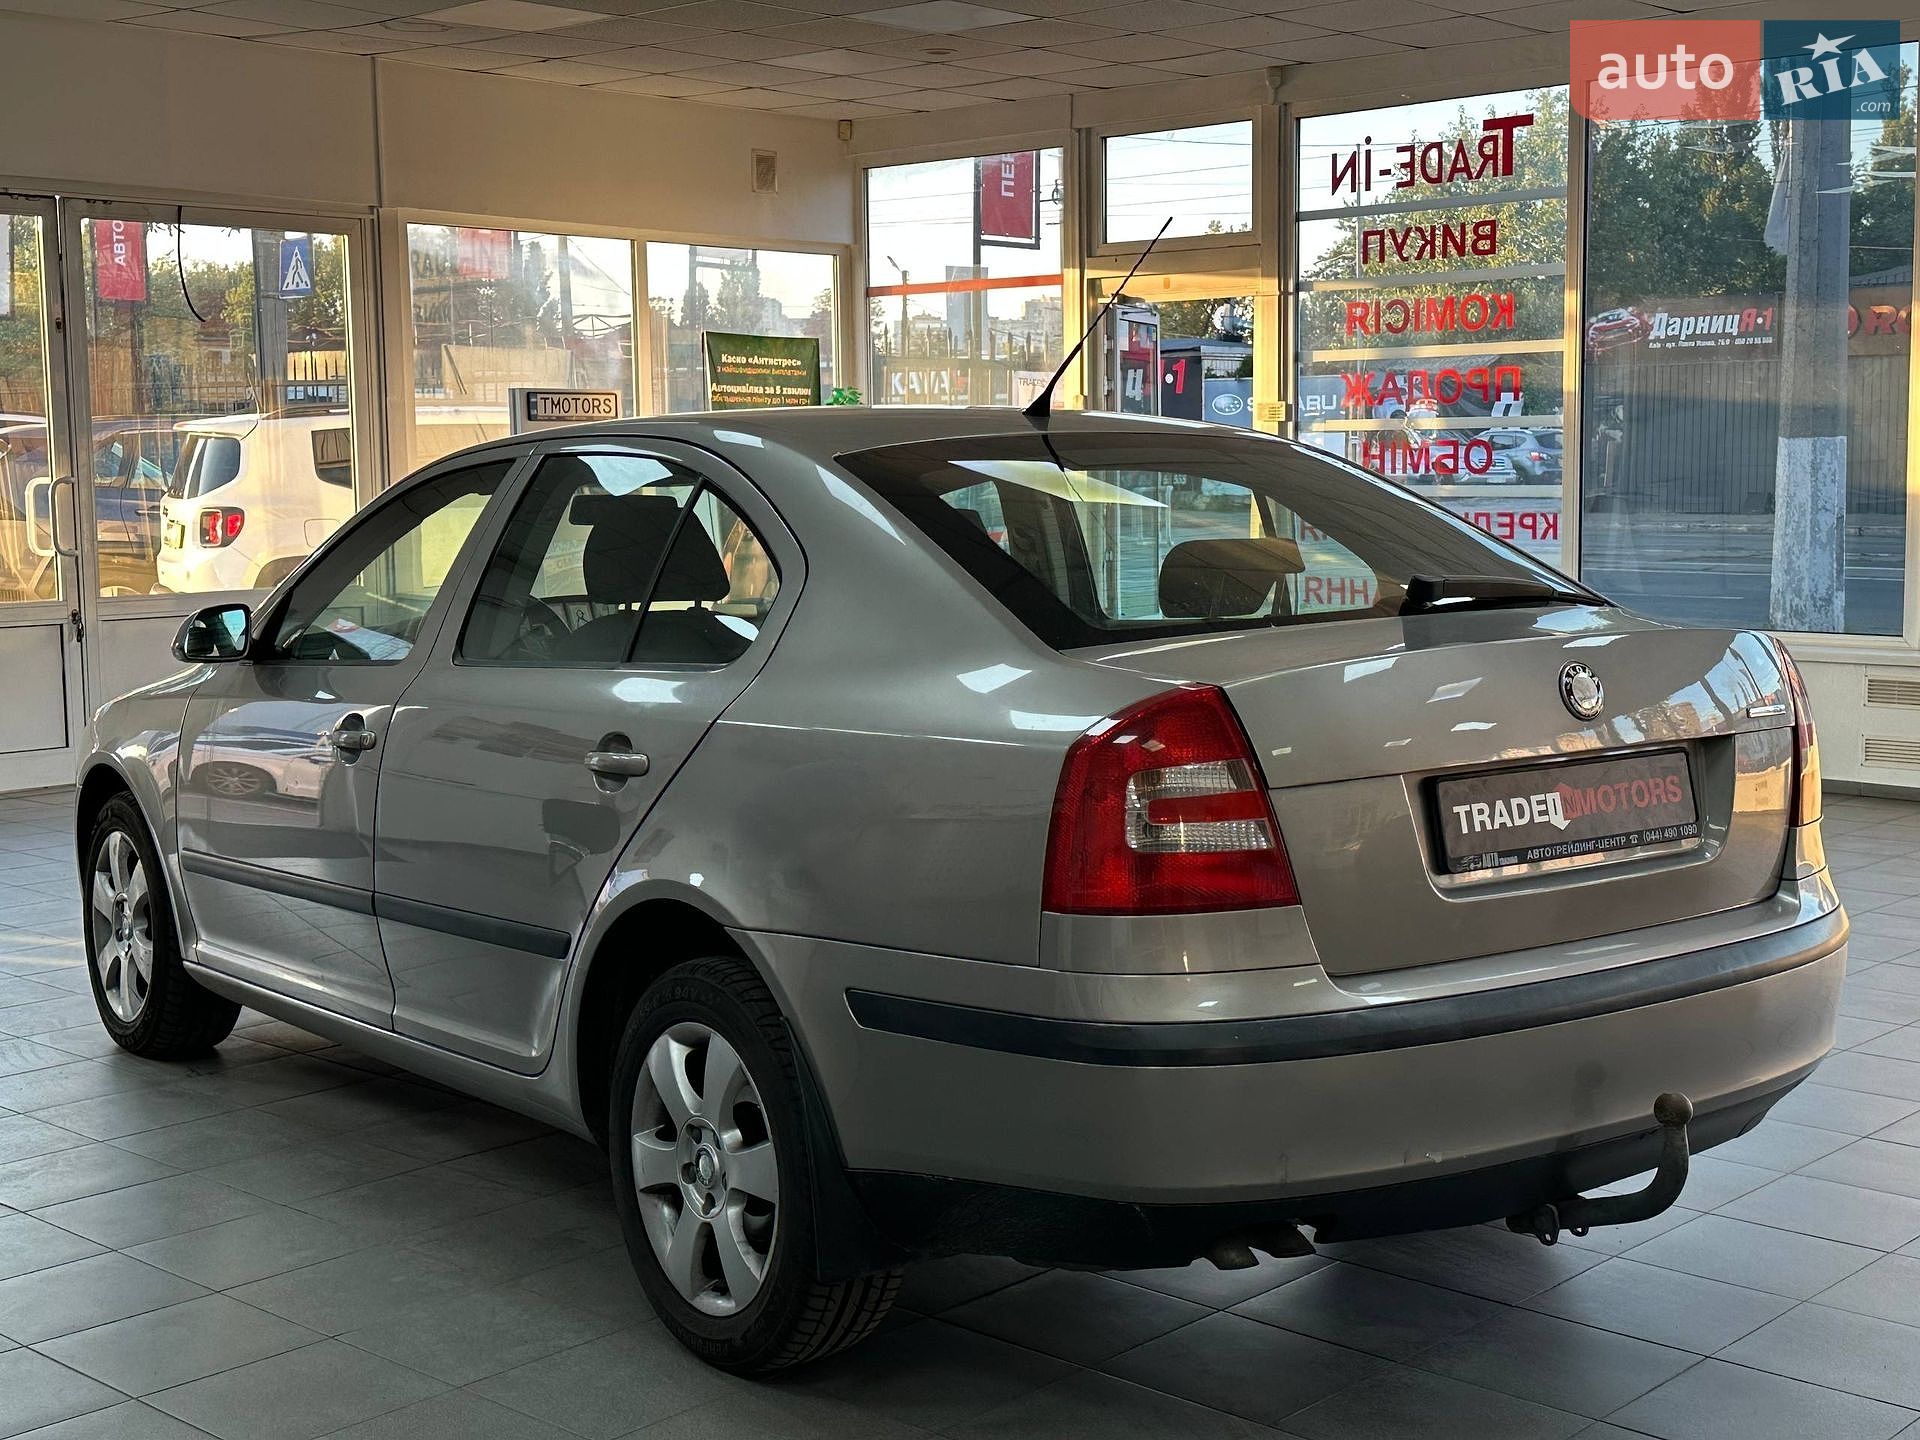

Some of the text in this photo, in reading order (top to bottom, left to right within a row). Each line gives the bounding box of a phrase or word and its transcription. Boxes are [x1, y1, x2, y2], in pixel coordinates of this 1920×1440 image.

[721, 354, 747, 364] Каско
[765, 386, 774, 395] за
[776, 386, 781, 395] 5
[540, 397, 612, 414] TMOTORS
[1453, 792, 1550, 834] TRADE
[1574, 775, 1682, 816] MOTORS
[1526, 837, 1627, 860] АВТОТРЕЙДИНГ-ЦЕНТР
[1643, 828, 1663, 844] (044)
[1664, 827, 1678, 840] 490
[1679, 824, 1698, 836] 1090
